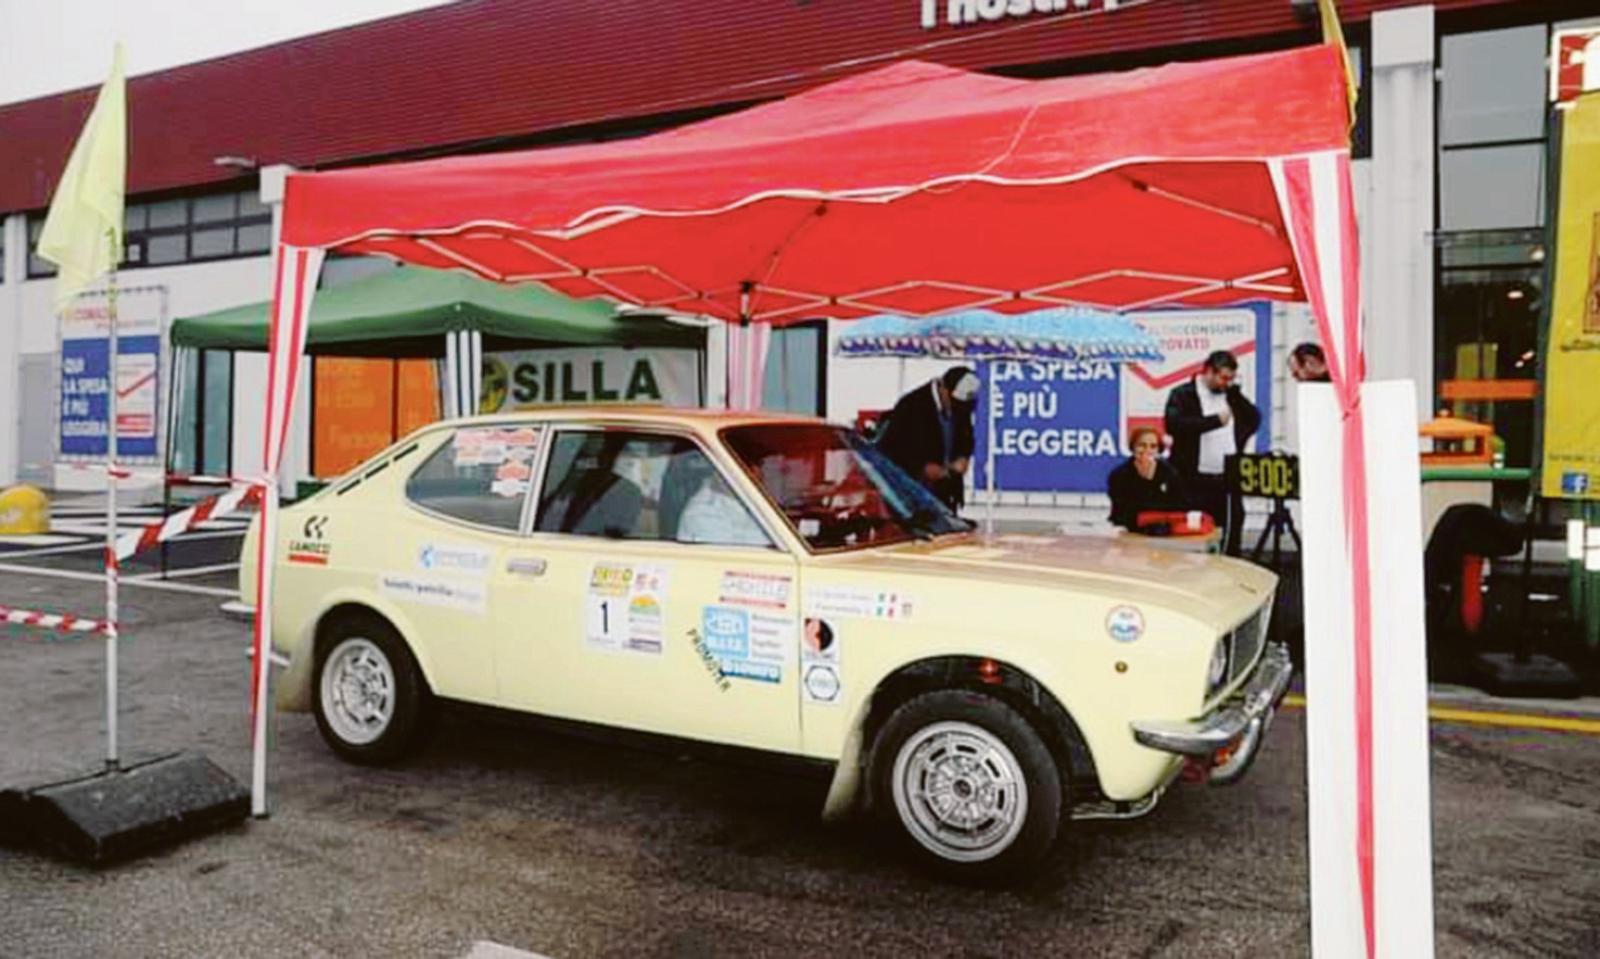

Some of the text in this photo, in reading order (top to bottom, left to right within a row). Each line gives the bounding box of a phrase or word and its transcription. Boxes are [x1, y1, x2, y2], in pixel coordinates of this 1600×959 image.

[512, 357, 662, 402] SILLA
[1031, 361, 1115, 381] SPESA
[1013, 383, 1057, 418] PIÙ
[991, 428, 1117, 457] LEGGERA
[600, 600, 609, 635] 1
